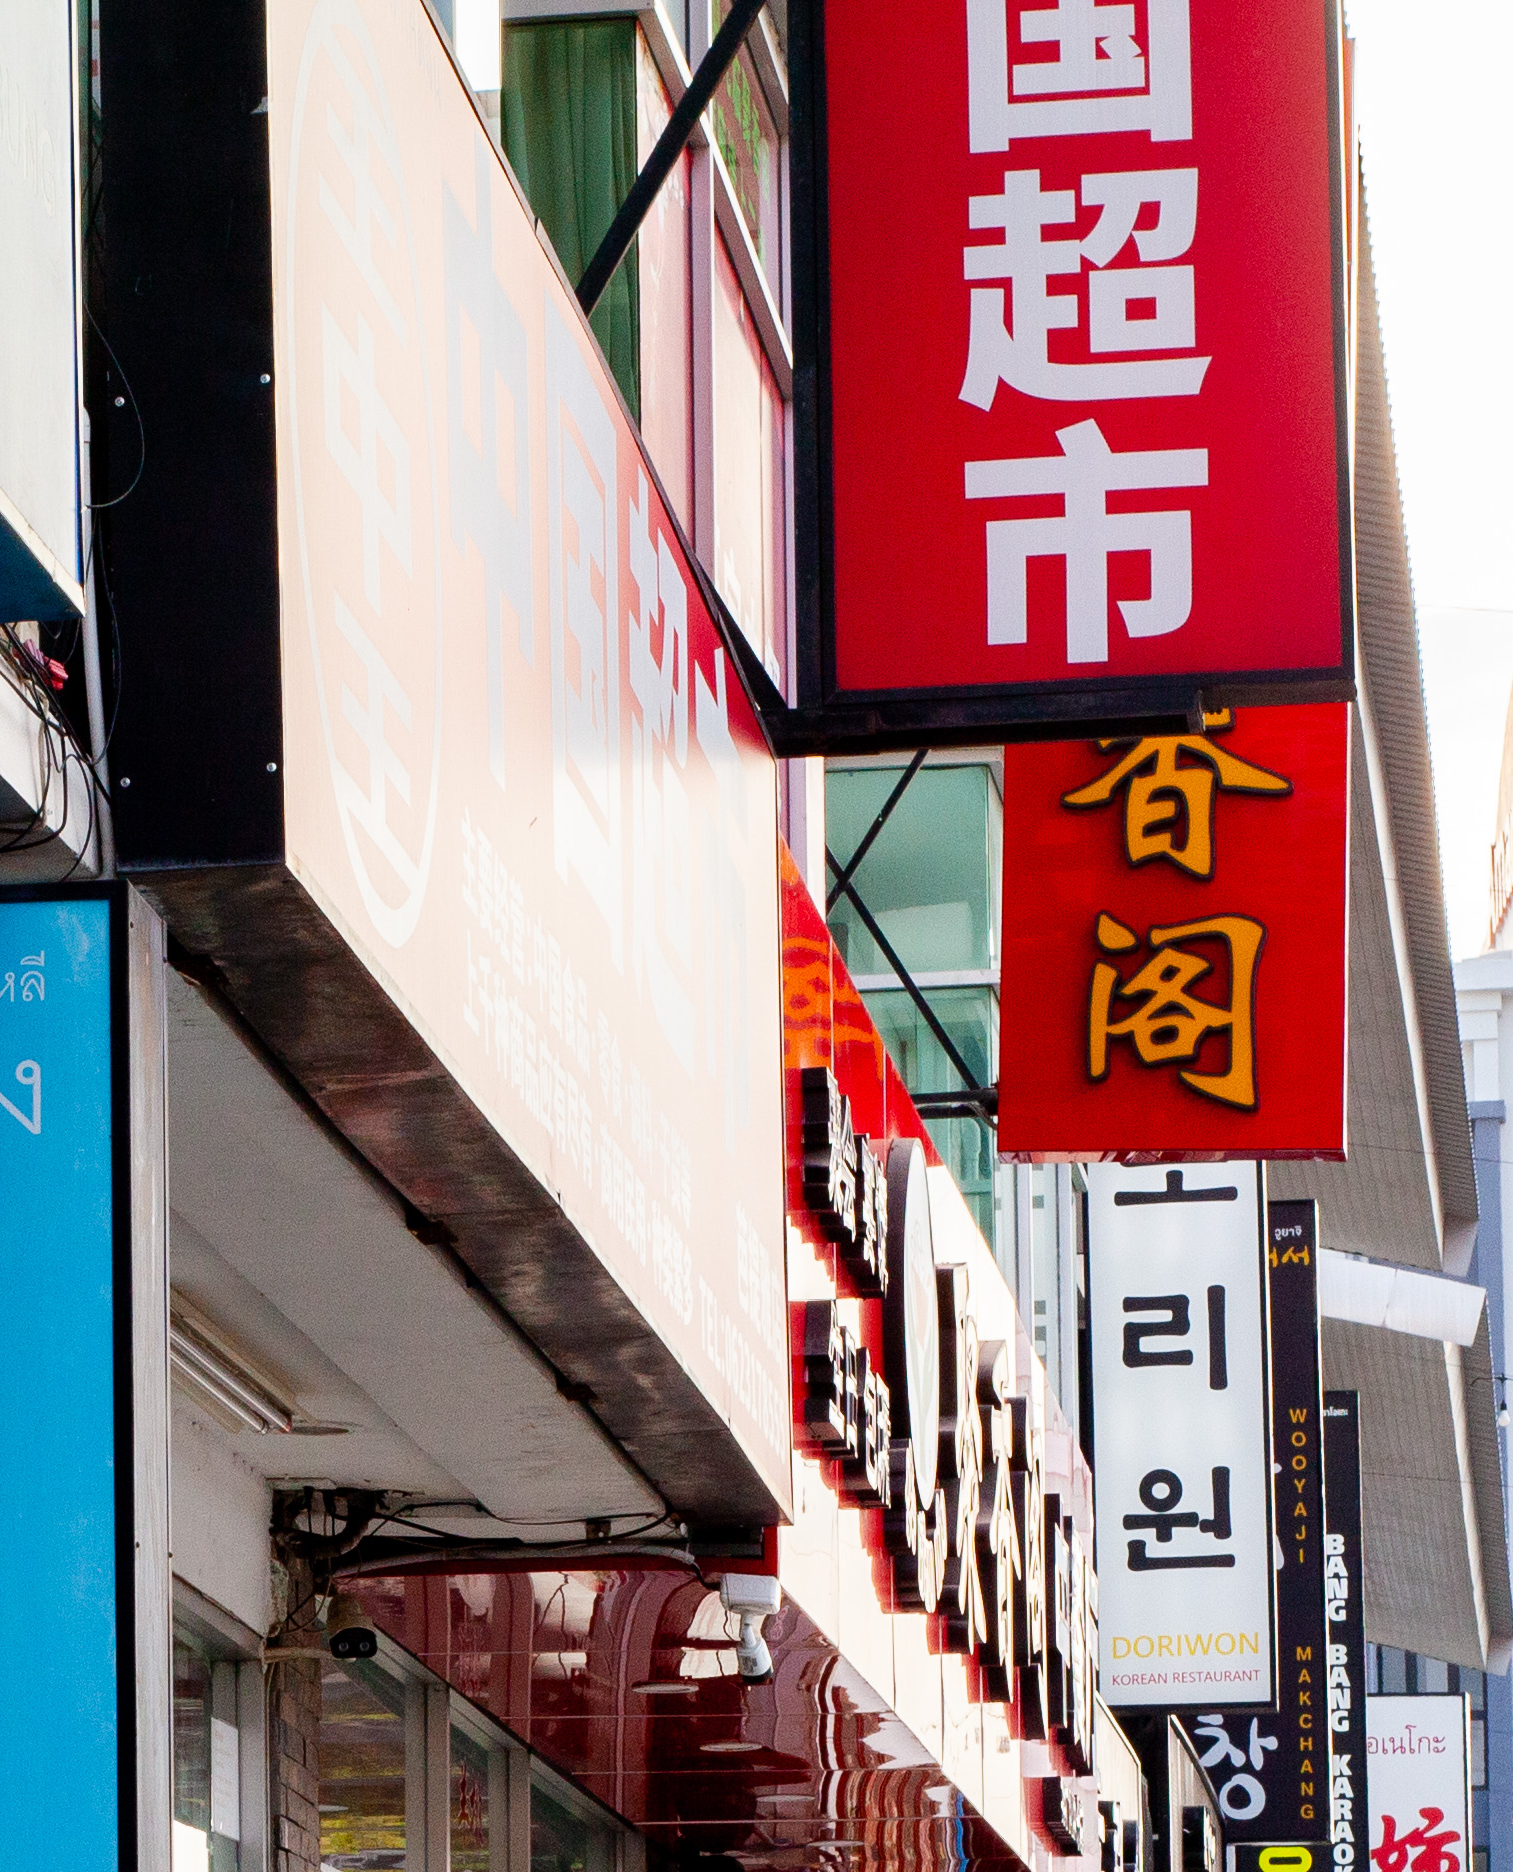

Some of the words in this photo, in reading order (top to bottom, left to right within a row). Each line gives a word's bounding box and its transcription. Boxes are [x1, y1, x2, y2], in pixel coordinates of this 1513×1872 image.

[958, 0, 1213, 664] 国超市
[1289, 1407, 1307, 1565] WOOYAJI
[1325, 1532, 1348, 1622] BANG
[1111, 1631, 1260, 1660] DORIWON
[1111, 1669, 1168, 1686] KOREAN
[1172, 1668, 1260, 1685] RESTAURANT
[1327, 1643, 1350, 1733] BANG
[1295, 1646, 1315, 1820] MAKCHANG
